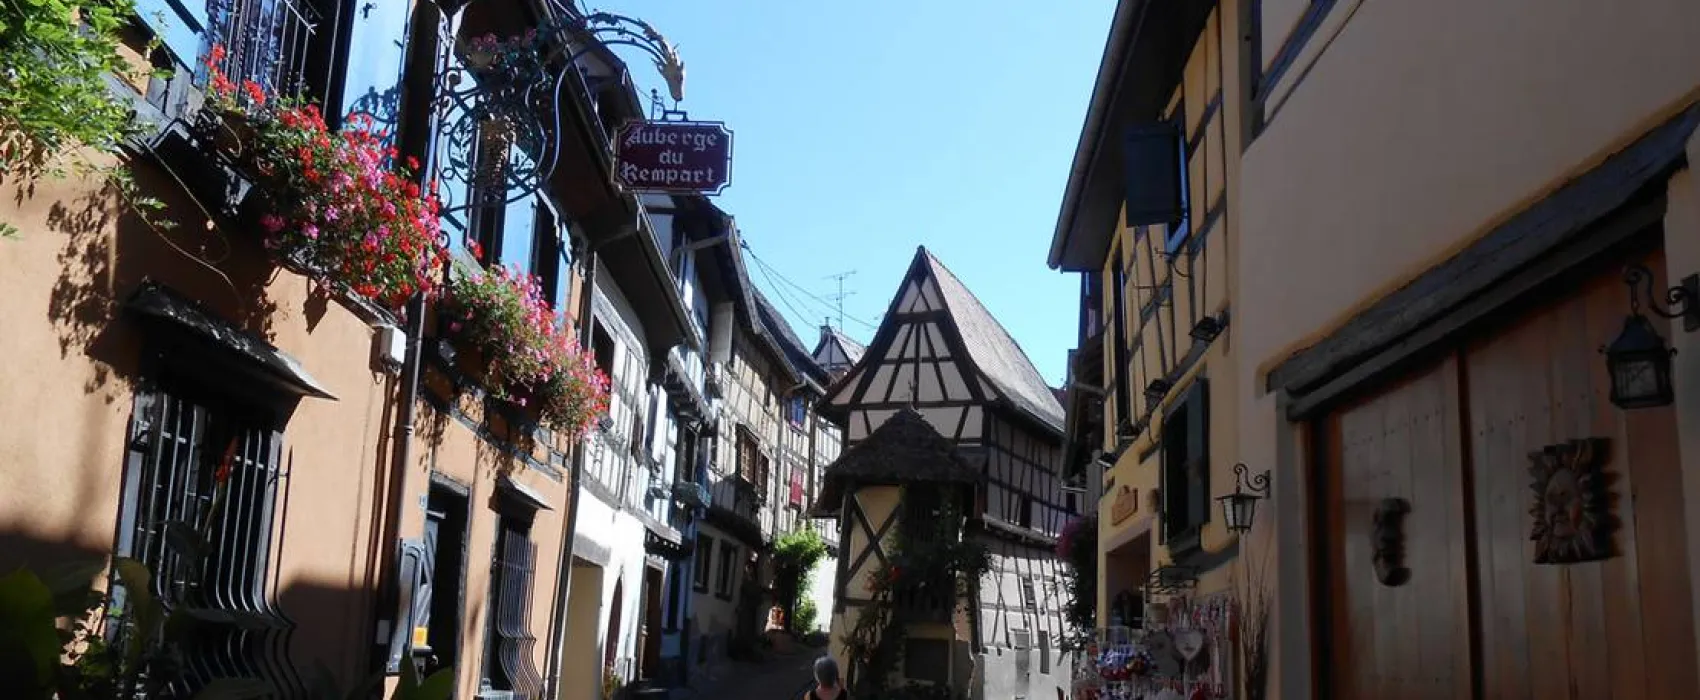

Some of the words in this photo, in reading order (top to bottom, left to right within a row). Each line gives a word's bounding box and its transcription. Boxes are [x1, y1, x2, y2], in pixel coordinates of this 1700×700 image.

[625, 127, 717, 151] Auberge
[659, 149, 683, 165] du
[620, 162, 716, 185] Rempart
